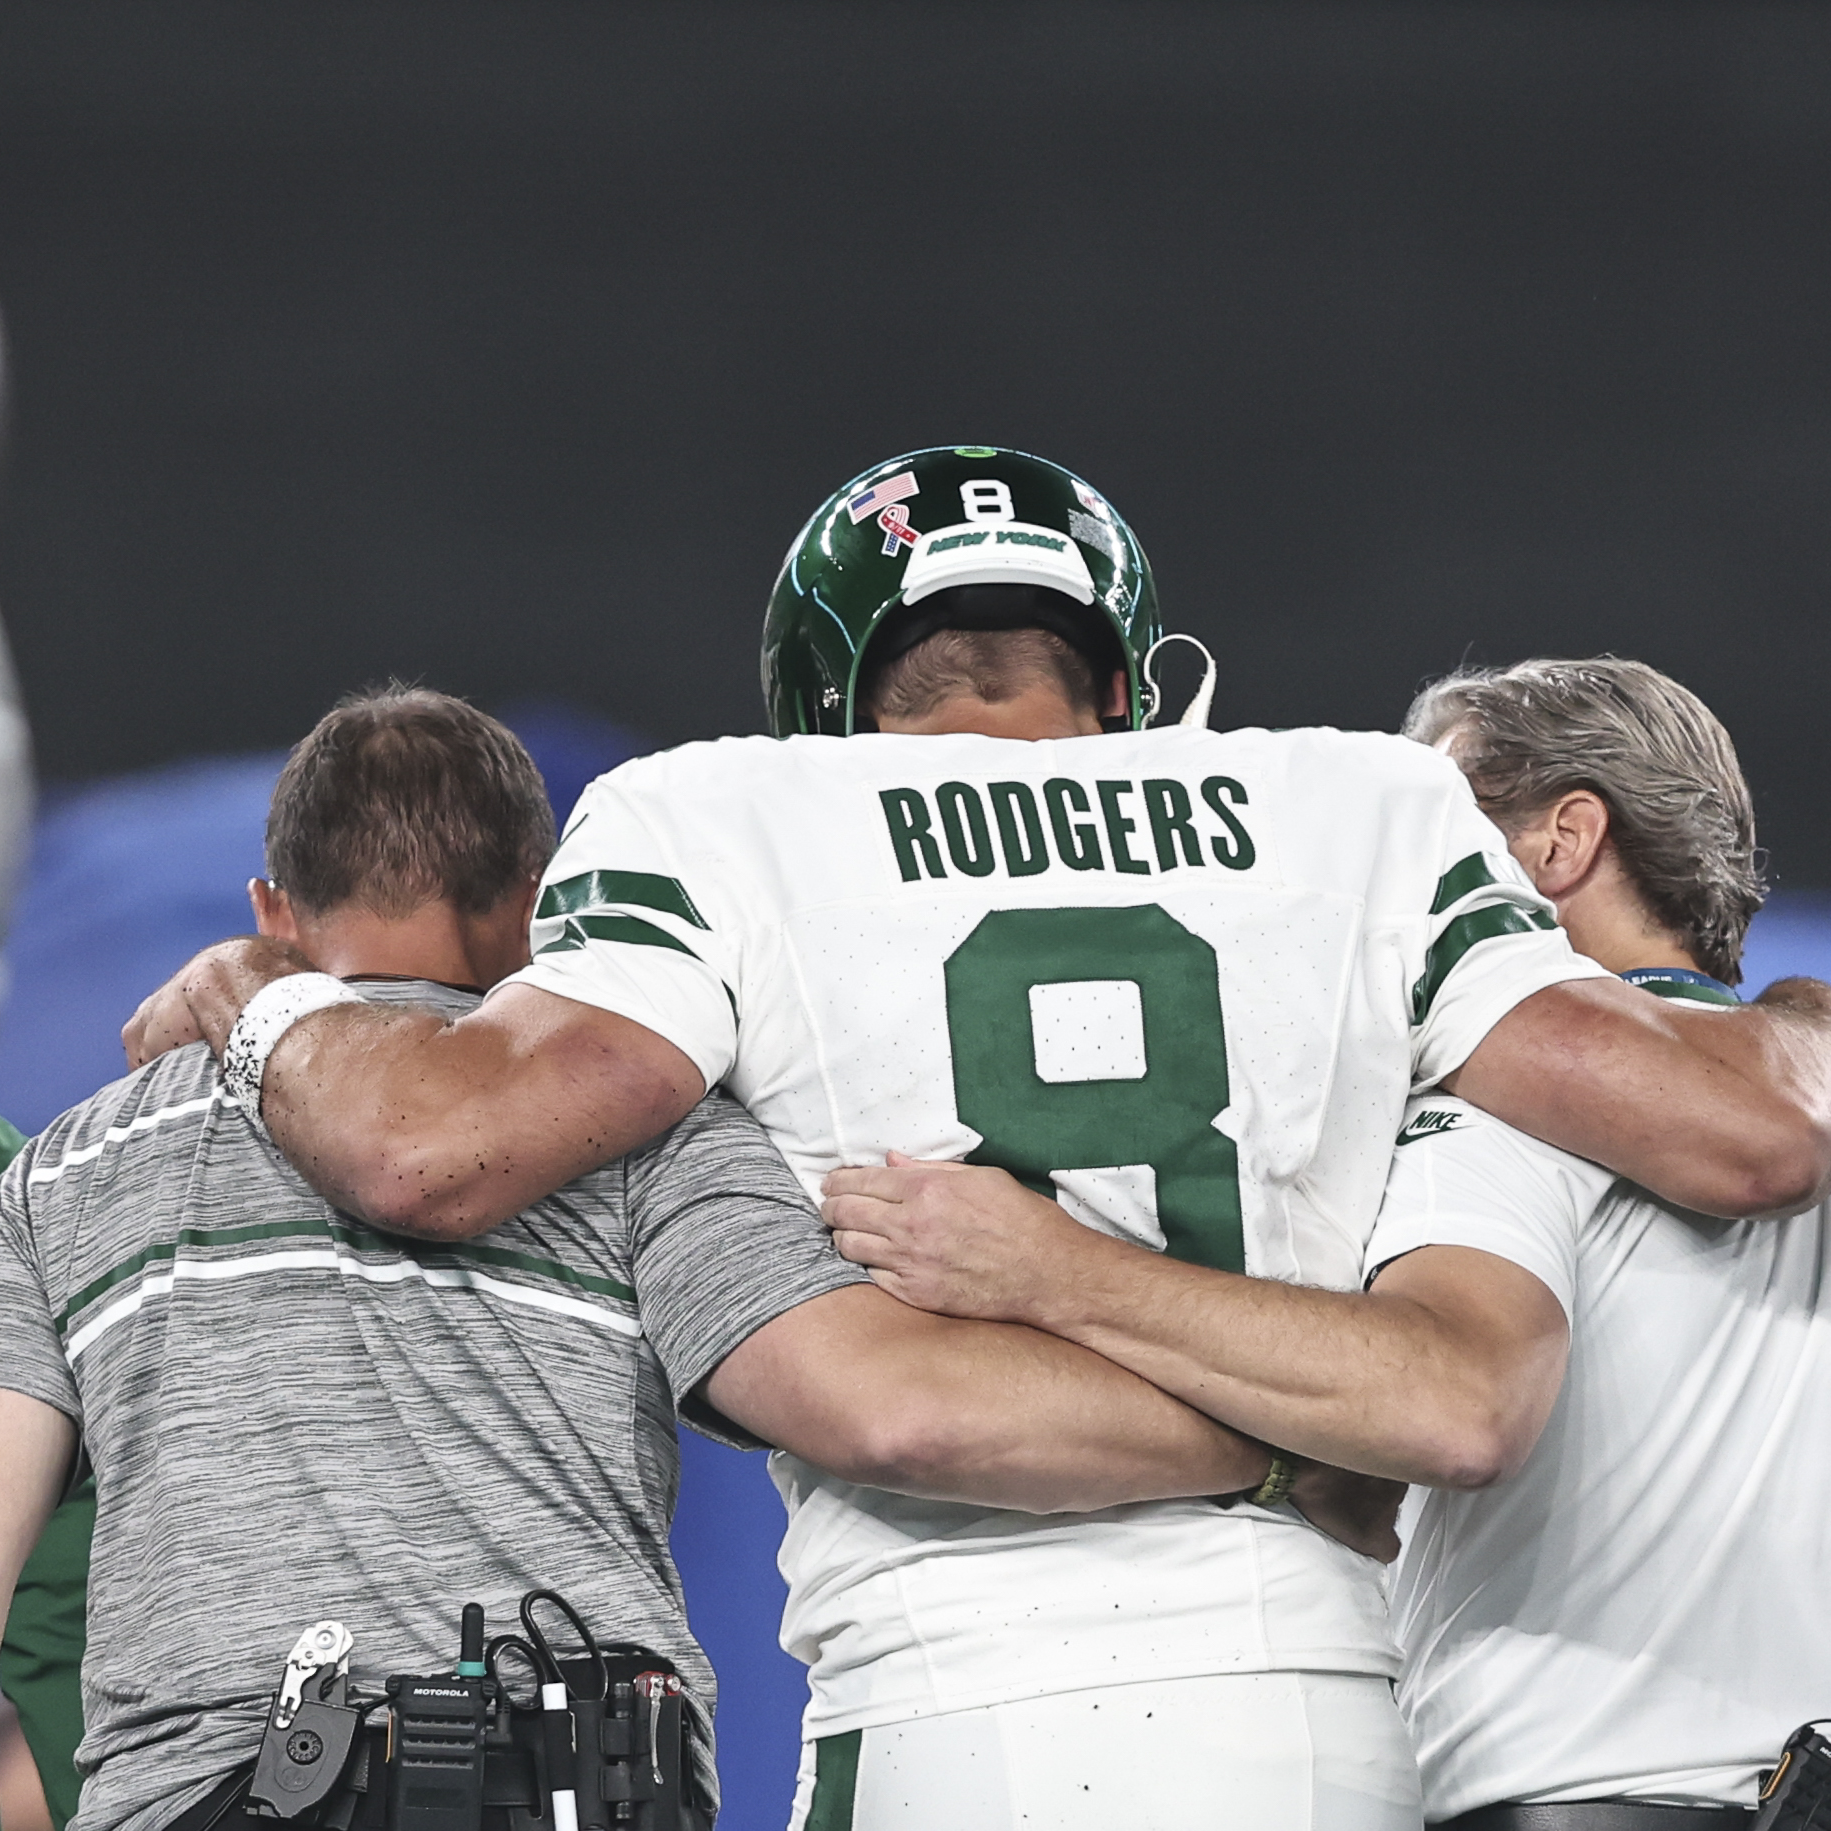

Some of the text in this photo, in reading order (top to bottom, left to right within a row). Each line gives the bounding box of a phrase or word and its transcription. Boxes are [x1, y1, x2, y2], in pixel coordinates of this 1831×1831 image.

[959, 479, 1015, 522] 8
[927, 531, 1067, 556] NEW YORK
[878, 776, 1256, 882] RODGERS
[943, 903, 1246, 1277] 8
[1408, 1110, 1463, 1130] NIKE
[413, 1688, 469, 1697] MOTOROLA
